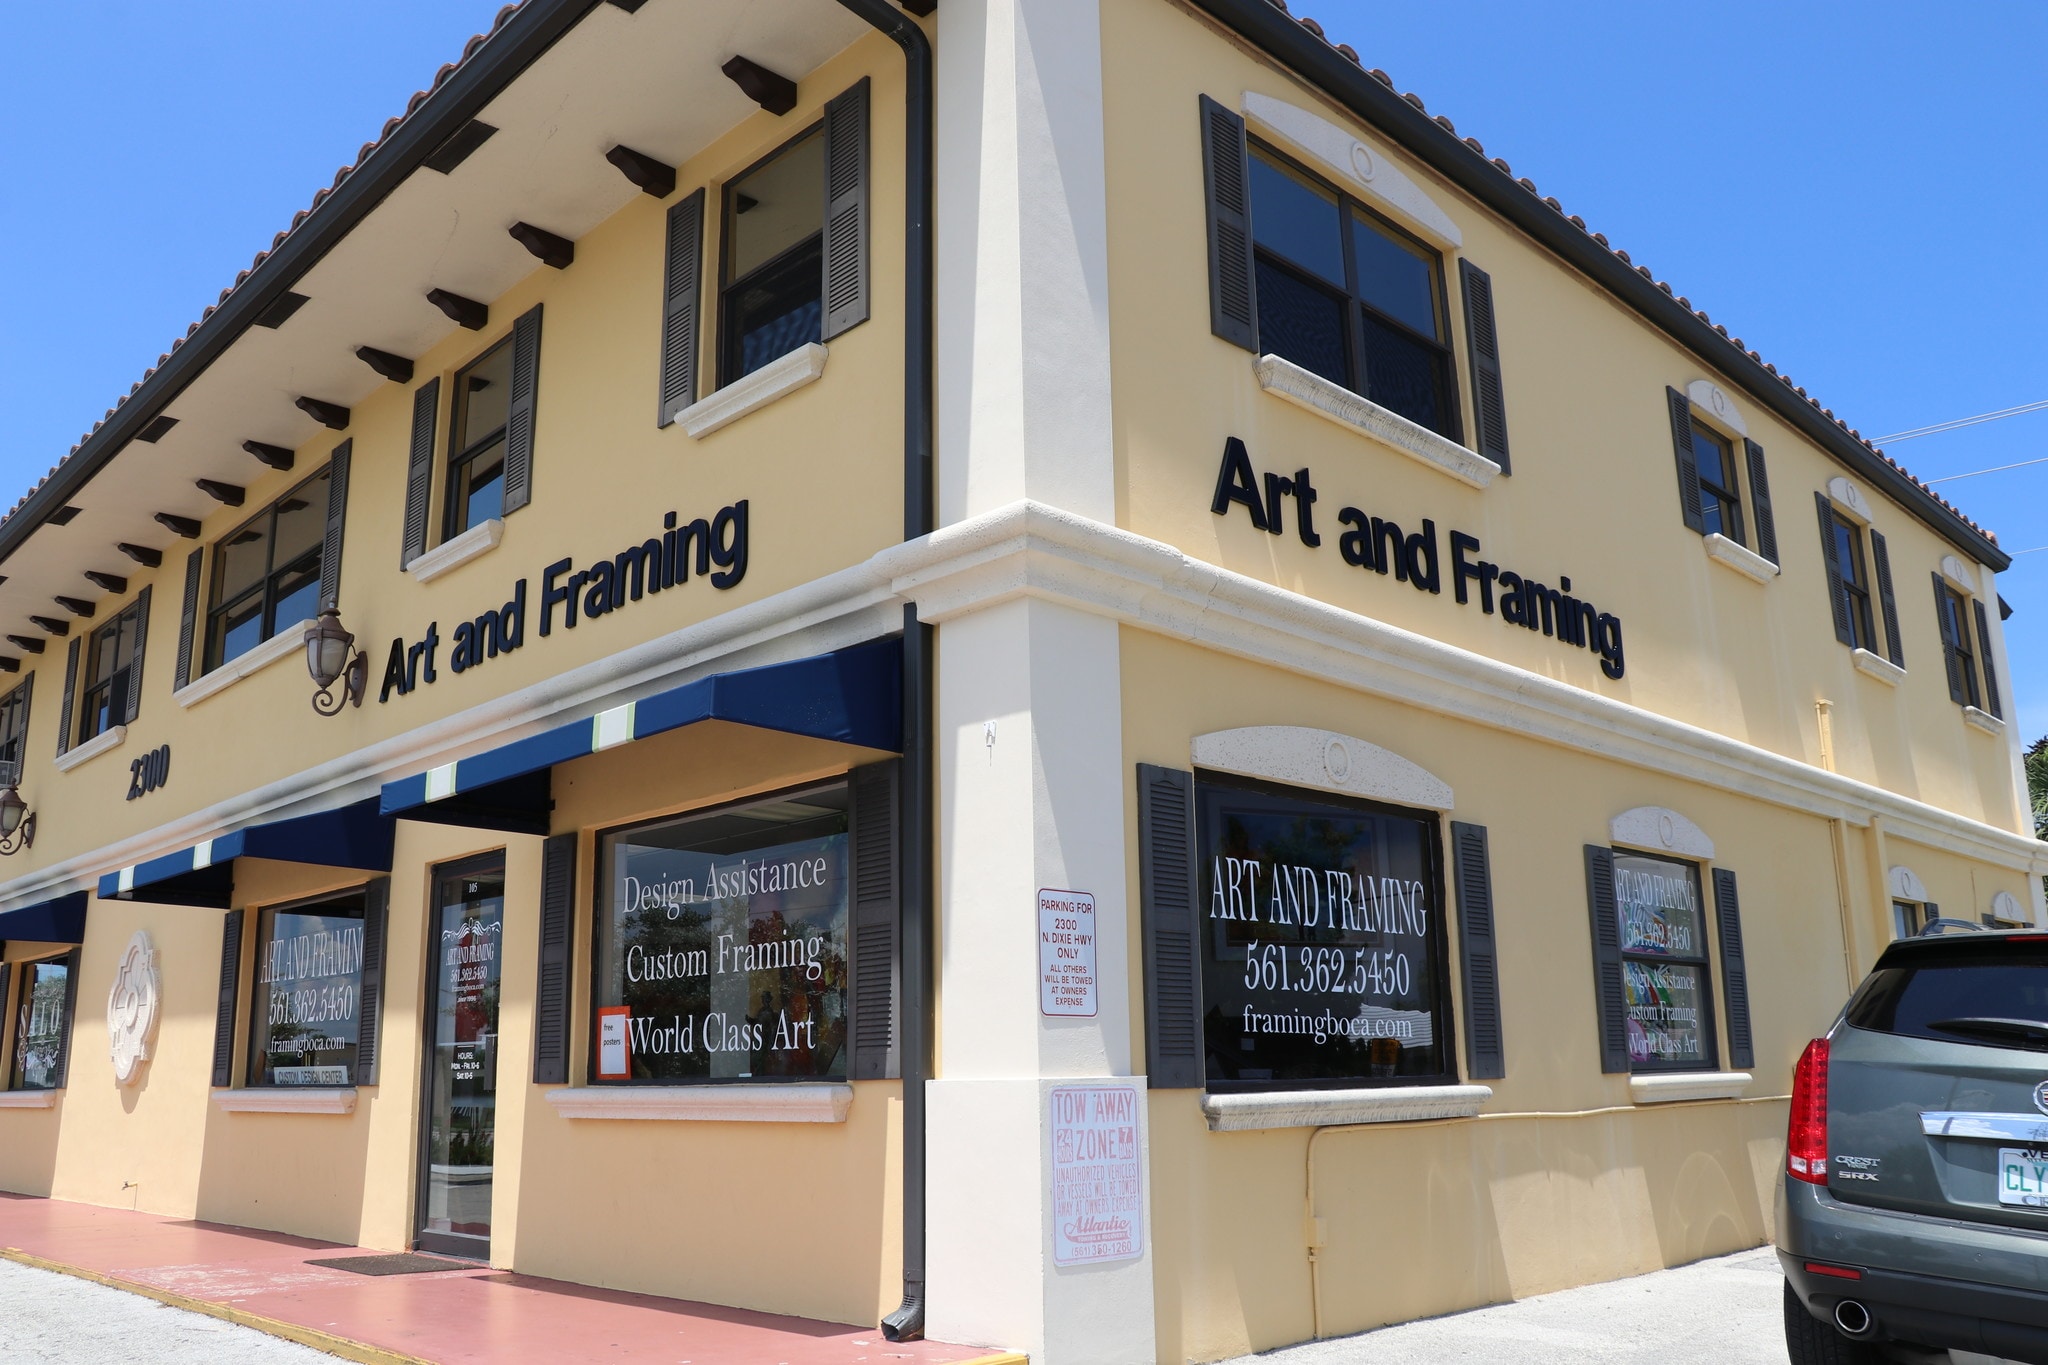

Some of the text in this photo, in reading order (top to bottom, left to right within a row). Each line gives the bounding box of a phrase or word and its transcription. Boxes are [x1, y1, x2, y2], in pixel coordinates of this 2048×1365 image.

[1211, 436, 1625, 680] Art and Framing
[378, 499, 749, 703] Art and Framing
[126, 744, 170, 800] 2300
[468, 882, 478, 894] 105
[623, 856, 827, 920] Design Assistance
[1210, 855, 1427, 938] ART AND FRAMING
[1634, 872, 1653, 905] AND
[1653, 874, 1695, 912] FRAMING
[1041, 899, 1092, 914] PARKING FOR
[1055, 918, 1077, 930] 2300
[1042, 932, 1092, 946] N. DIXIE HWY
[1627, 920, 1691, 951] 561.362.5450
[260, 926, 364, 984] ART AND FRAMIN
[469, 942, 494, 963] FRAMING
[627, 929, 823, 983] Custom Framing
[1057, 947, 1079, 959] ONLY
[1050, 964, 1087, 974] ALL OTHERS
[1244, 939, 1410, 996] 561.362.5450
[1044, 975, 1093, 985] WILL BE TOWED
[1051, 986, 1087, 995] AT OWNERS
[1623, 968, 1695, 995] esign Assistance
[268, 985, 353, 1025] 561.362.5450
[1055, 997, 1083, 1006] EXPENSE
[18, 999, 60, 1038] SALO
[1243, 1004, 1413, 1045] framingboca.com
[1660, 1000, 1697, 1028] Framing
[603, 1023, 613, 1032] free
[625, 1008, 816, 1055] World Class Art
[270, 1034, 345, 1058] framingboca.com
[603, 1038, 621, 1047] posters
[1658, 1033, 1682, 1054] Class
[1684, 1034, 1699, 1053] Art
[278, 1070, 343, 1084] CUSTOM DESIGN CENTER
[1055, 1092, 1133, 1124] TOW AWAY
[1057, 1129, 1072, 1147] 24
[1076, 1129, 1117, 1161] ZONE
[1122, 1128, 1129, 1143] 7
[1835, 1155, 1881, 1168] CREST
[1056, 1163, 1136, 1183] UNAUTHORIZED VEHICLES
[1838, 1170, 1880, 1182] SRX
[2006, 1163, 2046, 1192] CLY
[1056, 1184, 1065, 1200] OR
[1067, 1182, 1092, 1200] VESSELS
[1095, 1181, 1107, 1197] WILL
[1118, 1179, 1136, 1195] TOWED
[1064, 1215, 1130, 1234] Atlantic
